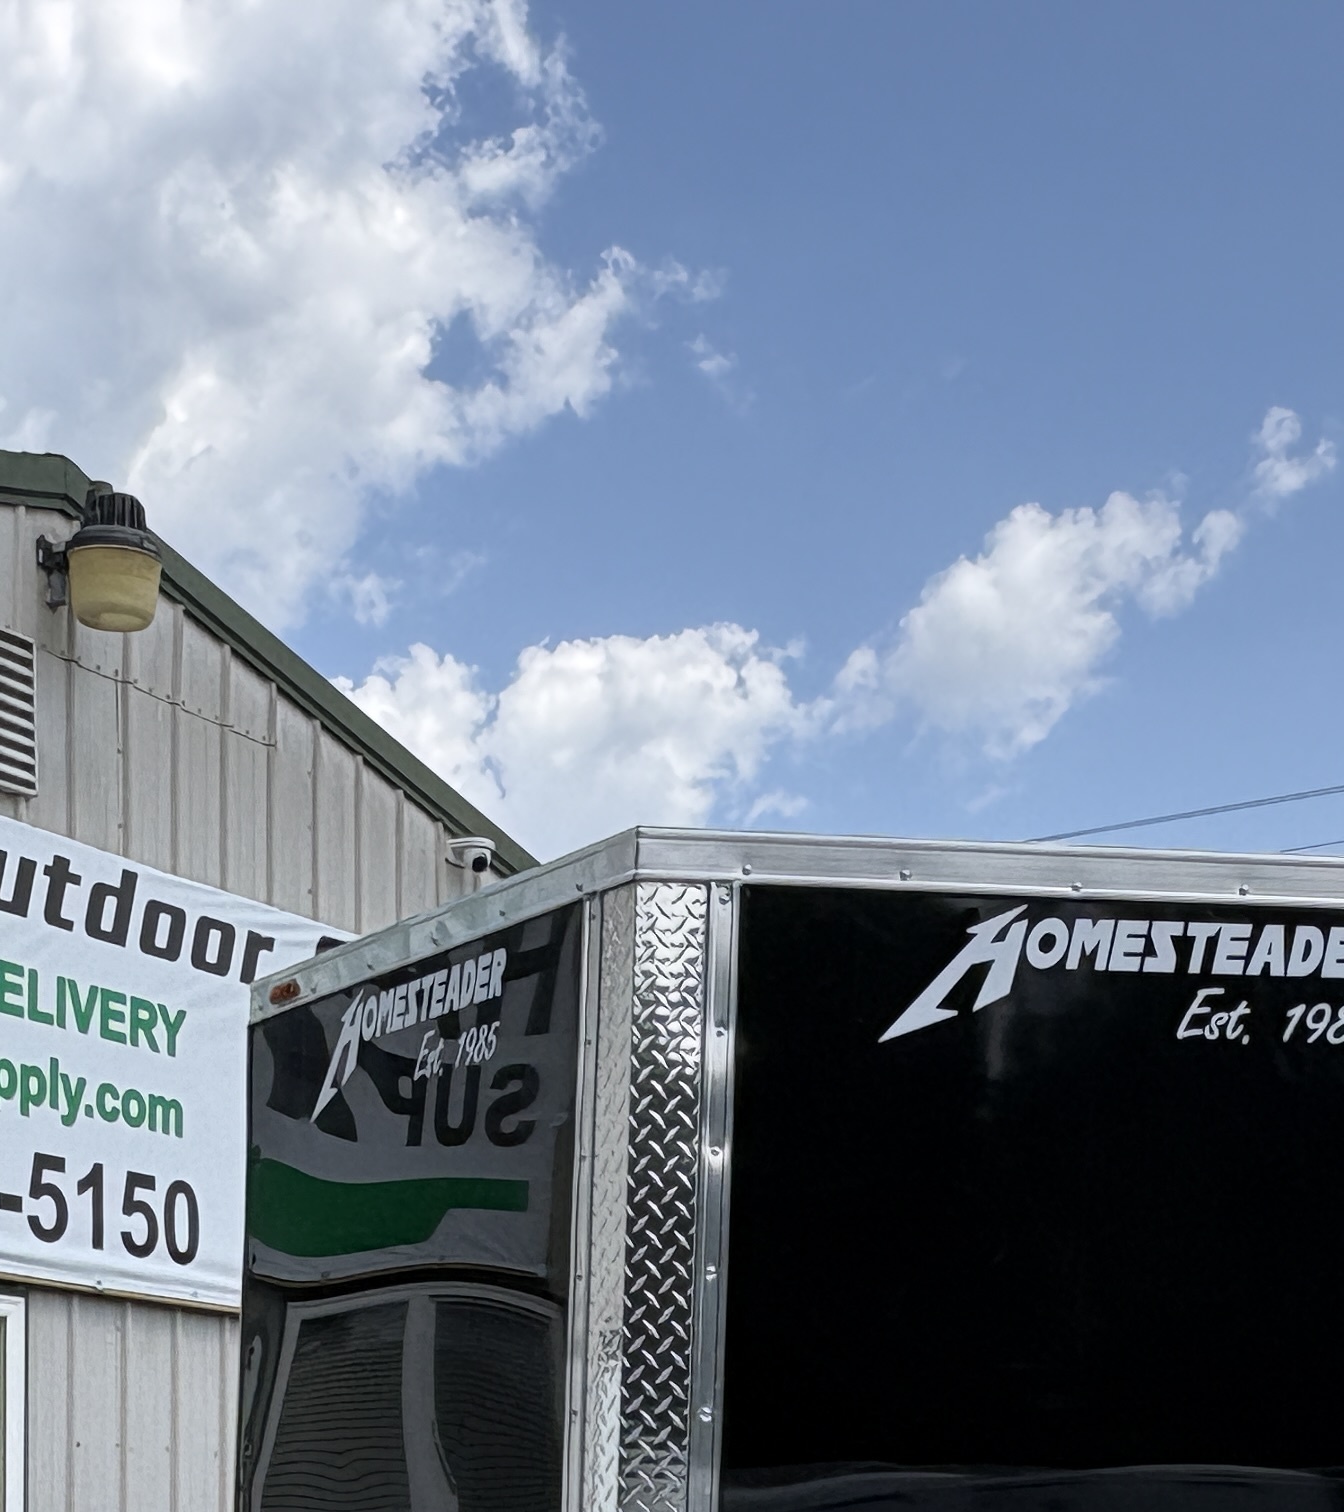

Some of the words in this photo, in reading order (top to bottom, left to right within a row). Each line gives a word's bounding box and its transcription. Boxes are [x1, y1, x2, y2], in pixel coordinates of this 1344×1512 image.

[310, 947, 508, 1123] HOMESTEADER
[1177, 987, 1251, 1045] Est.
[414, 1029, 445, 1081] Est.
[455, 1020, 501, 1069] 1985
